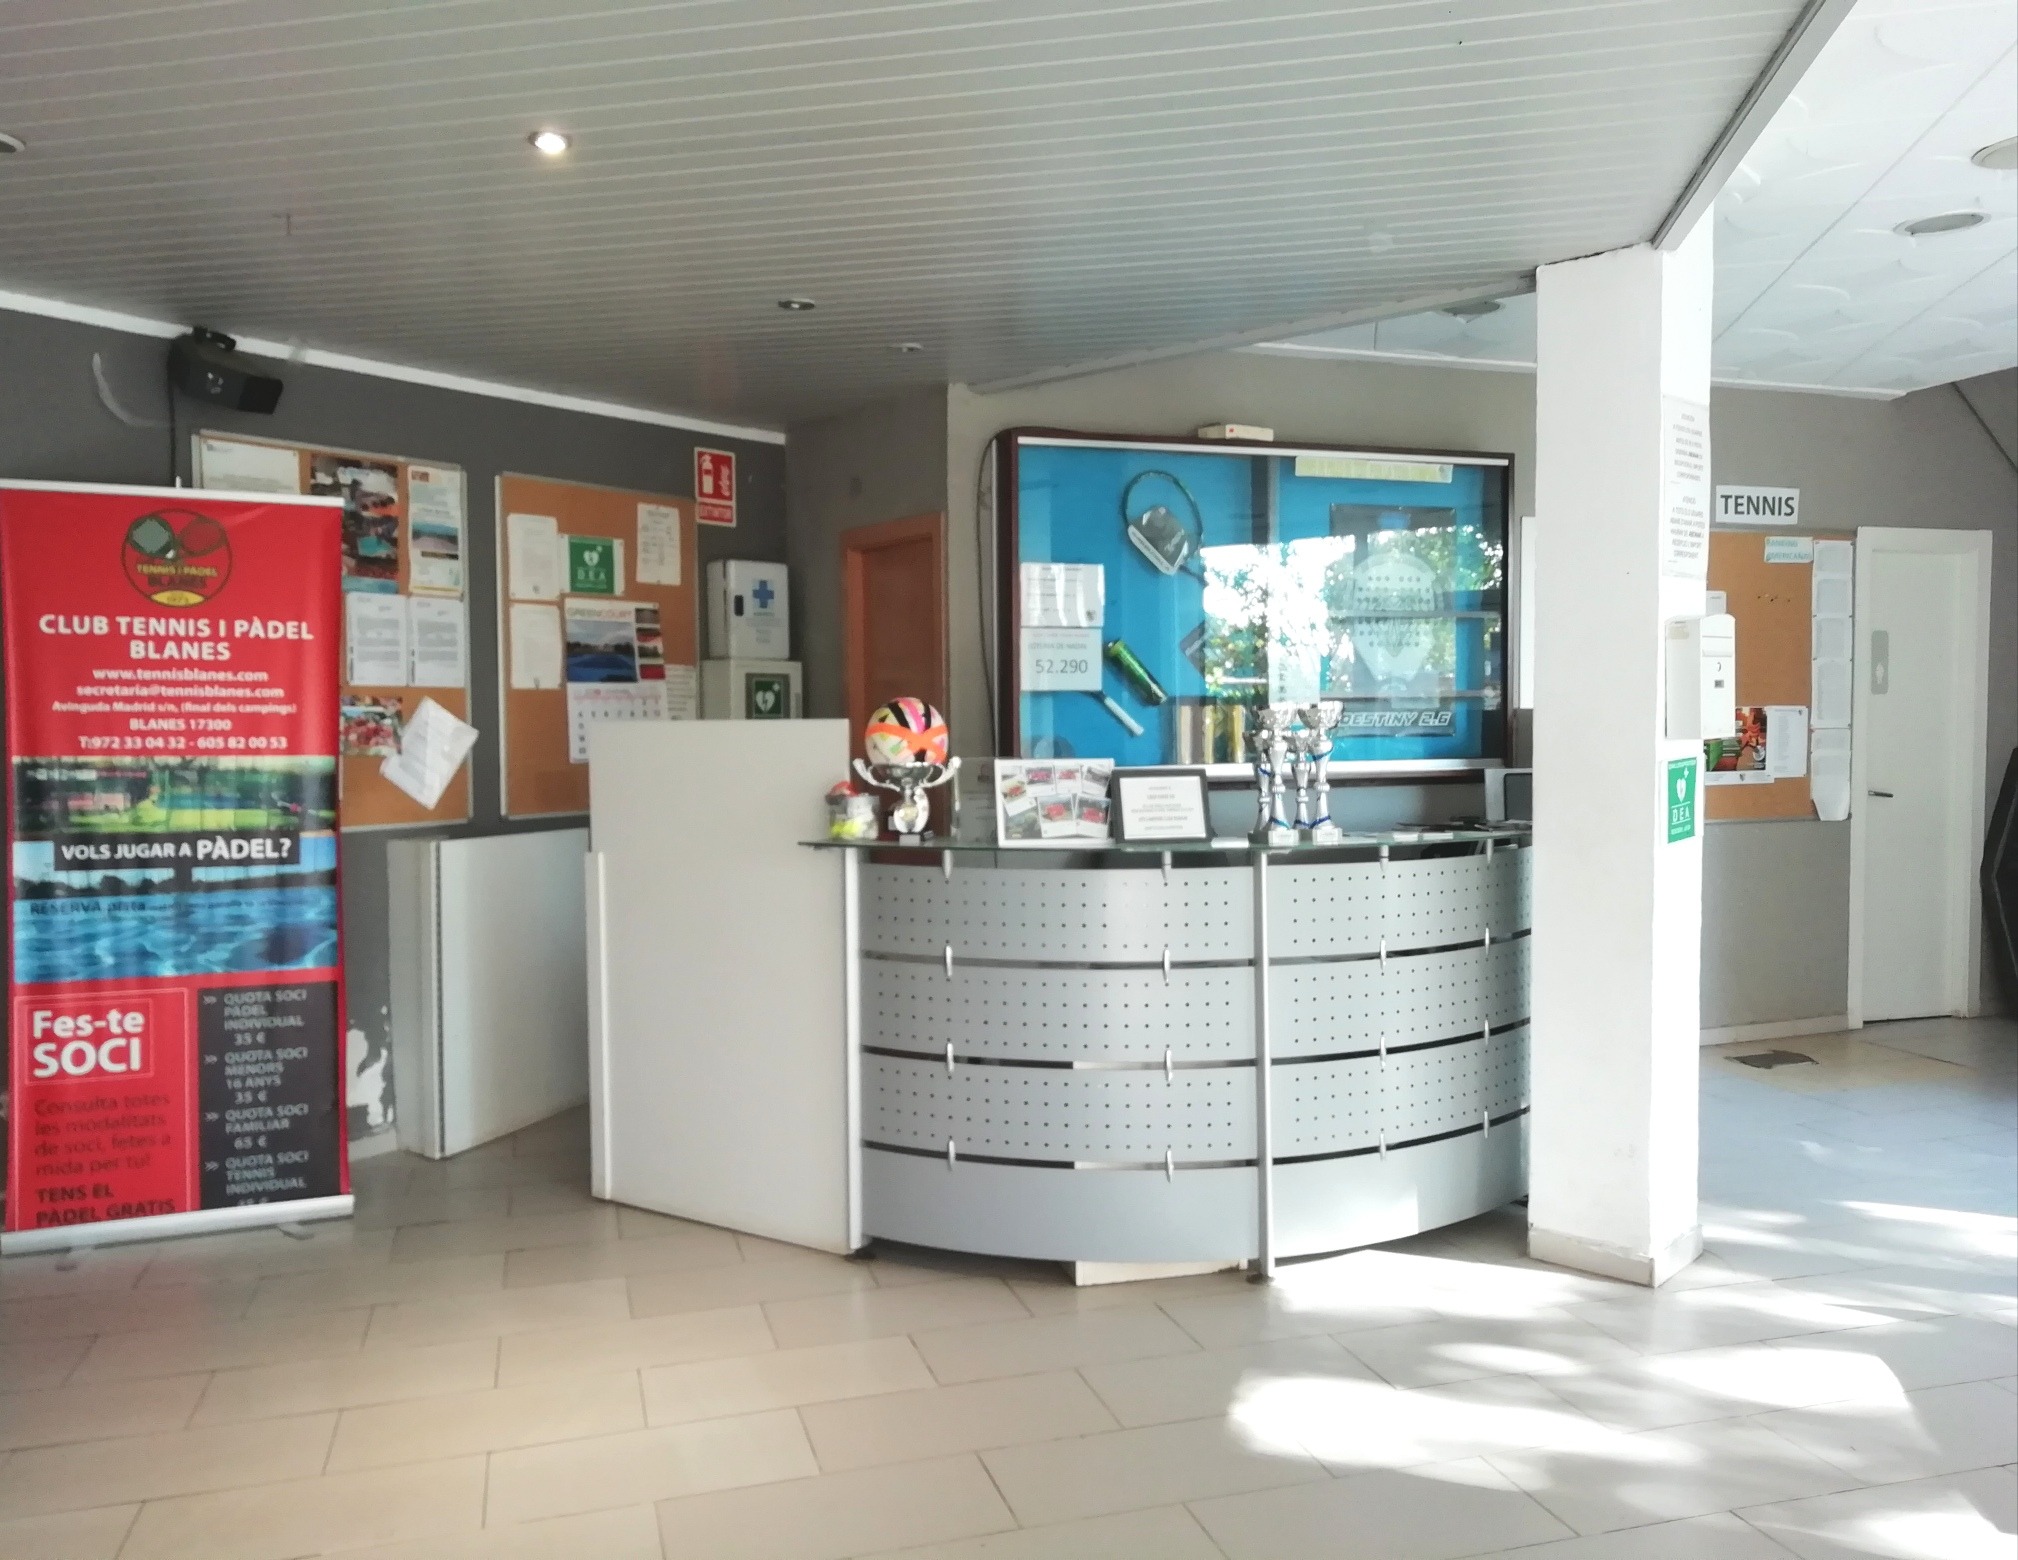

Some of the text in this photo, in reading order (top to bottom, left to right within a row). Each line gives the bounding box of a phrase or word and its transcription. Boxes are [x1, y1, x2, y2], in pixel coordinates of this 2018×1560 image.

[1720, 494, 1795, 517] TENNIS
[39, 614, 314, 640] CLUB TENNIS I PÀDEL
[129, 640, 231, 661] BLANES
[92, 668, 269, 682] www.tennisblanes.com
[1035, 659, 1088, 674] 52.290
[76, 685, 285, 699] secretaria@tennisblanes.com
[52, 701, 110, 714] Avinguda
[112, 701, 156, 713] Madrid
[213, 703, 237, 713] dels
[129, 718, 233, 731] BLANES 17300
[1340, 711, 1418, 727] DESTINY
[124, 737, 142, 749] 33
[145, 737, 165, 749] 04
[168, 737, 187, 749] 32
[197, 737, 225, 749] 605
[249, 737, 268, 749] 00
[269, 737, 288, 749] 53
[1672, 806, 1690, 823] DEA
[62, 835, 292, 860] VOLS JUGAR A PÀDEL?
[224, 989, 308, 1006] QUOTA SOCI
[33, 1008, 145, 1039] Fes-te
[224, 1015, 305, 1031] INDIVIDUAL
[33, 1036, 141, 1078] SOCI
[224, 1046, 309, 1064] QUOTA SOCI
[225, 1061, 284, 1076] MENORS
[245, 1074, 282, 1089] ANYS
[34, 1093, 170, 1116] Consulta totes
[225, 1103, 310, 1121] QUOTA SOCI
[35, 1114, 167, 1137] les modalitats
[225, 1118, 290, 1134] FAMILIAR
[34, 1140, 60, 1156] de
[112, 1133, 157, 1149] fetes
[161, 1134, 172, 1146] a
[36, 1160, 85, 1177] mida
[89, 1156, 120, 1173] per
[225, 1150, 310, 1169] QUOTA SOCI
[225, 1166, 275, 1180] TENNIS
[36, 1183, 114, 1203] TENS EL
[225, 1177, 307, 1195] INDIVIDUAL
[106, 1199, 176, 1219] GRATIS
